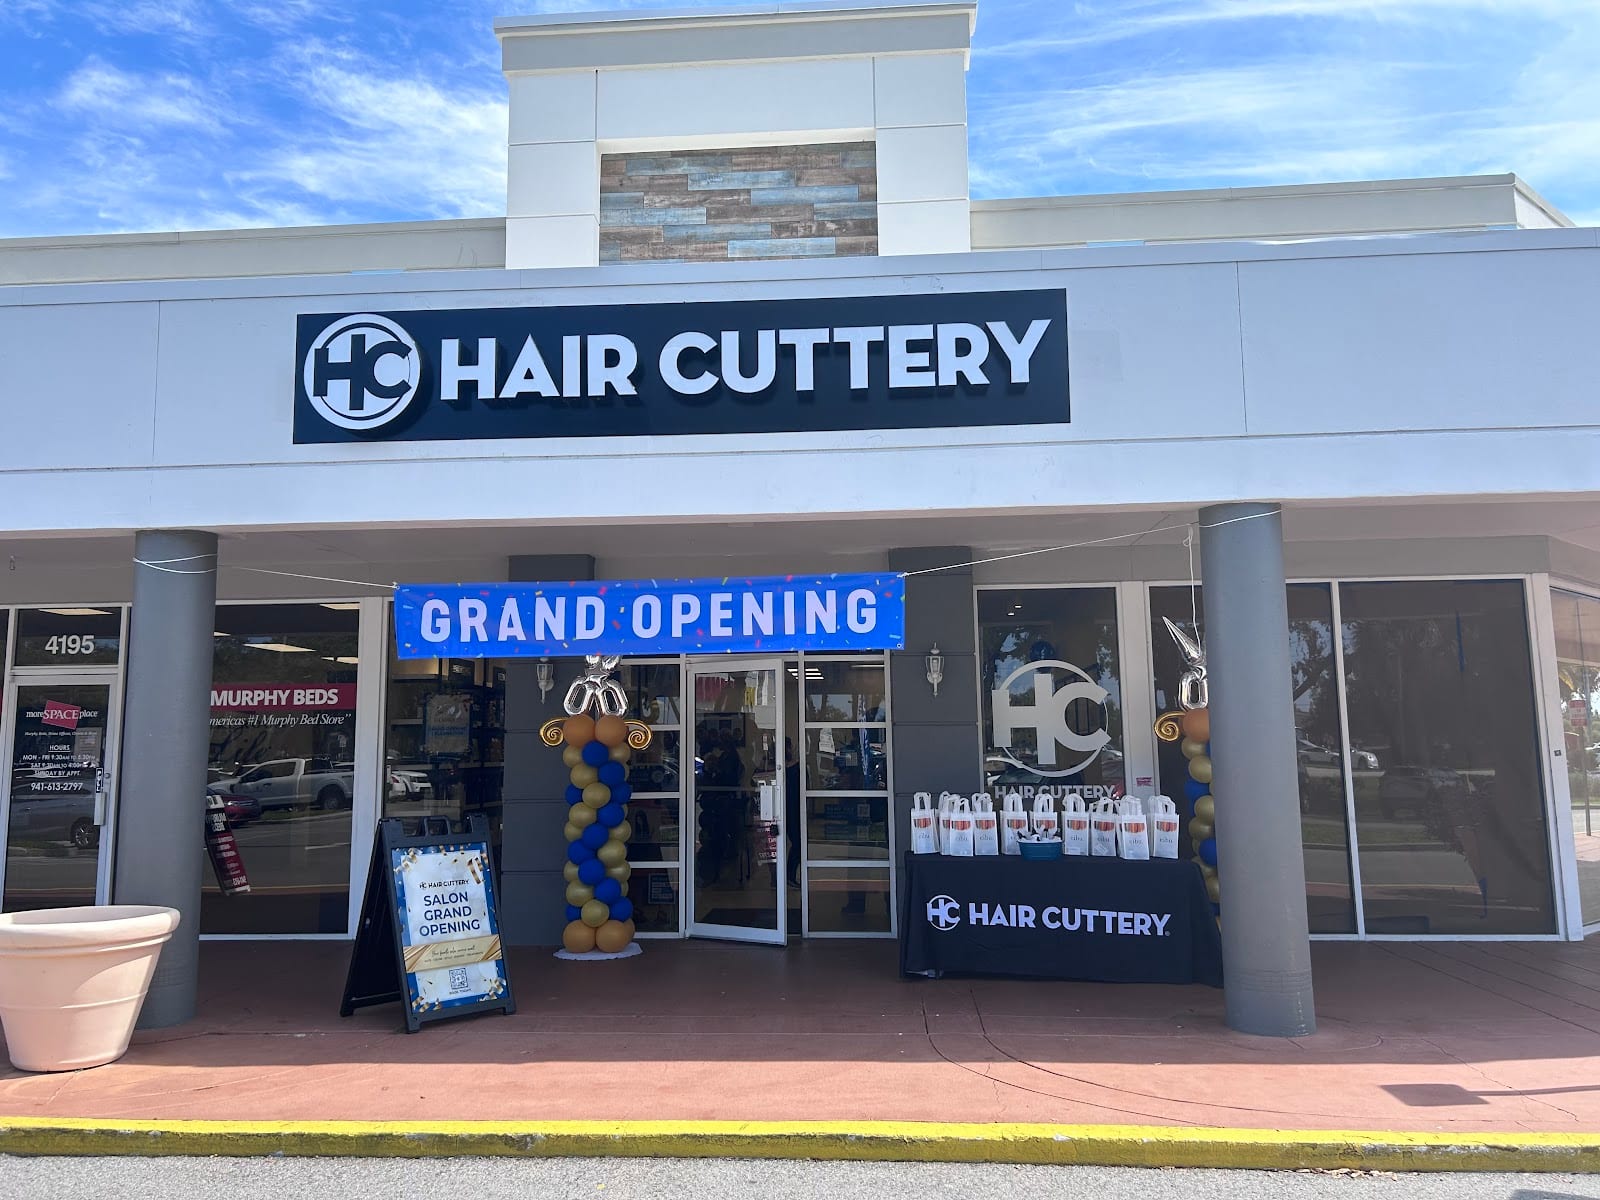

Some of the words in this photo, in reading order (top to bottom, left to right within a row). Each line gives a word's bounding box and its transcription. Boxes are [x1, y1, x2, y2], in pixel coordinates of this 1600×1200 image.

[440, 334, 638, 401] HAIR
[658, 319, 1052, 396] CUTTERY
[420, 595, 606, 643] GRAND
[631, 588, 878, 639] OPENING
[45, 635, 95, 654] 4195
[210, 689, 292, 706] MURPHY
[293, 688, 339, 705] BEDS
[209, 715, 245, 726] mericas
[248, 714, 259, 726] #1
[261, 714, 300, 728] Murphy
[300, 713, 319, 725] Bed
[992, 673, 1112, 765] HC
[31, 782, 83, 791] 941-613-2797
[995, 785, 1035, 799] HAIR
[1037, 784, 1116, 799] CUTTERY
[429, 881, 442, 889] HAIR
[443, 879, 470, 887] CUTTERY
[423, 890, 469, 907] SALON
[424, 906, 472, 921] GRAND
[926, 898, 961, 927] HC
[968, 902, 1036, 929] HAIR
[419, 918, 481, 937] OPENING
